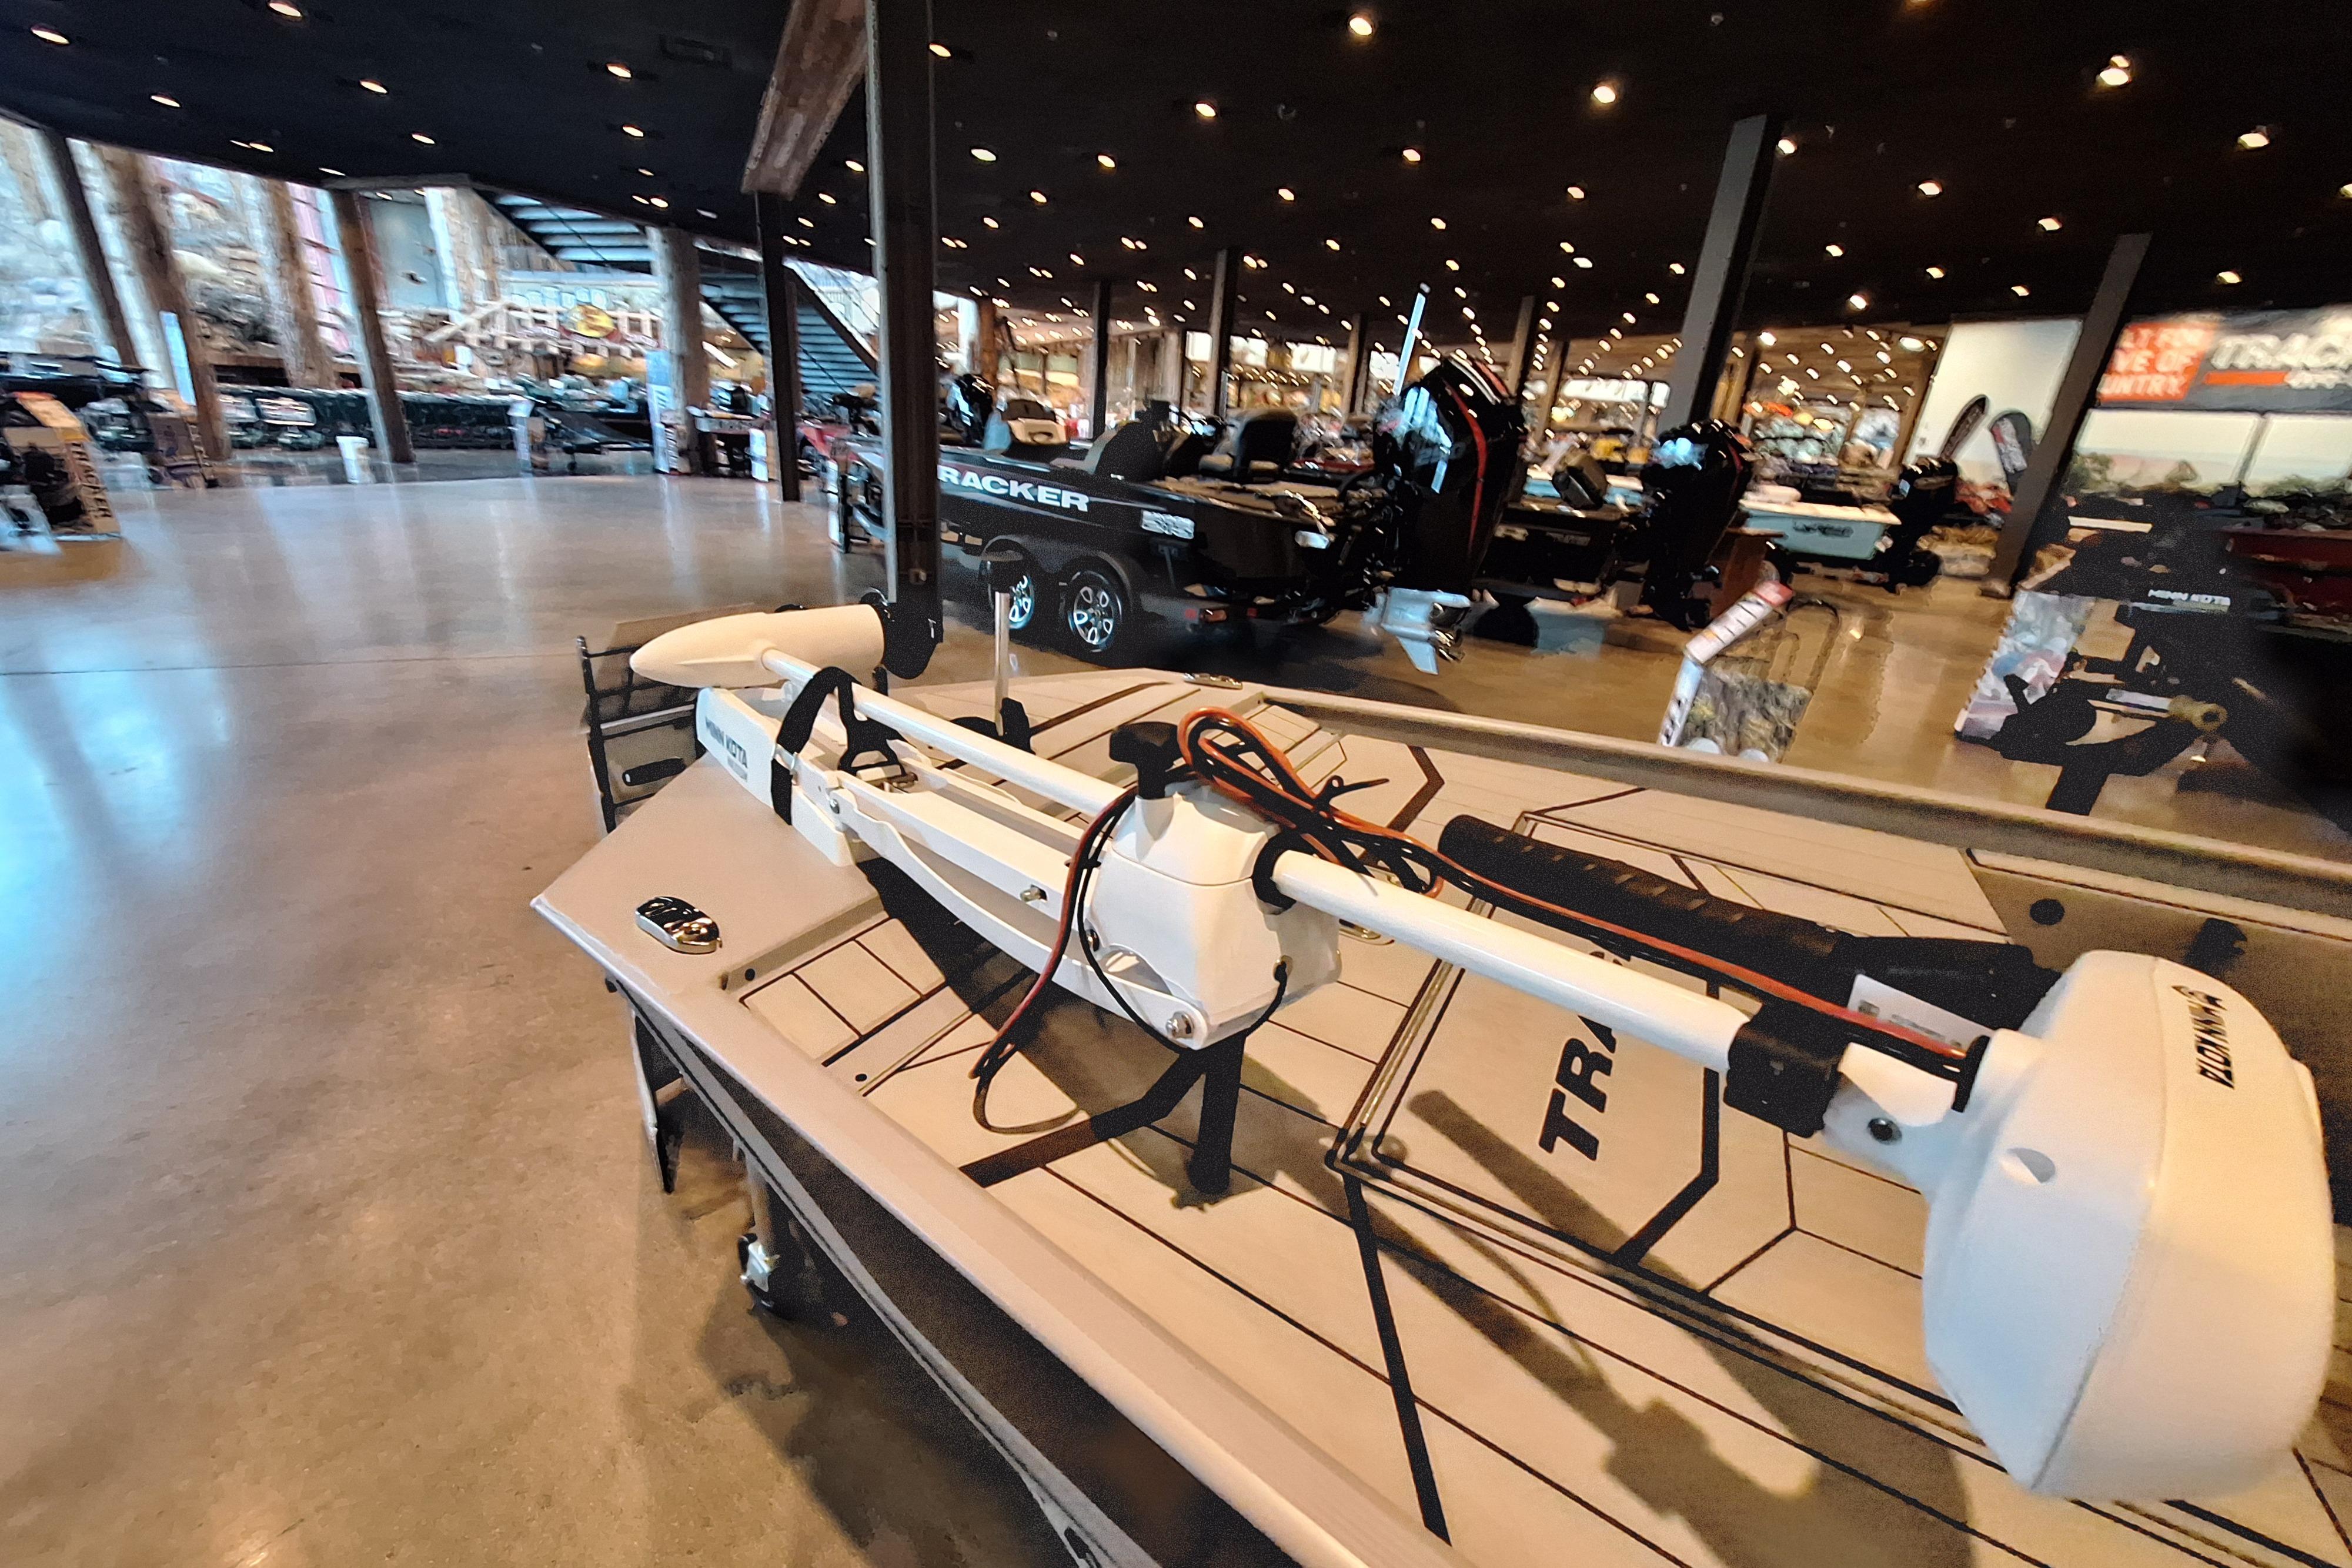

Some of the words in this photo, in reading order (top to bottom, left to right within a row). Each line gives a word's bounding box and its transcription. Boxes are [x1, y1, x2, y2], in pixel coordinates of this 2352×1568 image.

[2211, 333, 2352, 369] TRAC
[2097, 373, 2186, 397] UNTRY
[937, 464, 1089, 512] RACKER
[1538, 1015, 1617, 1161] TR
